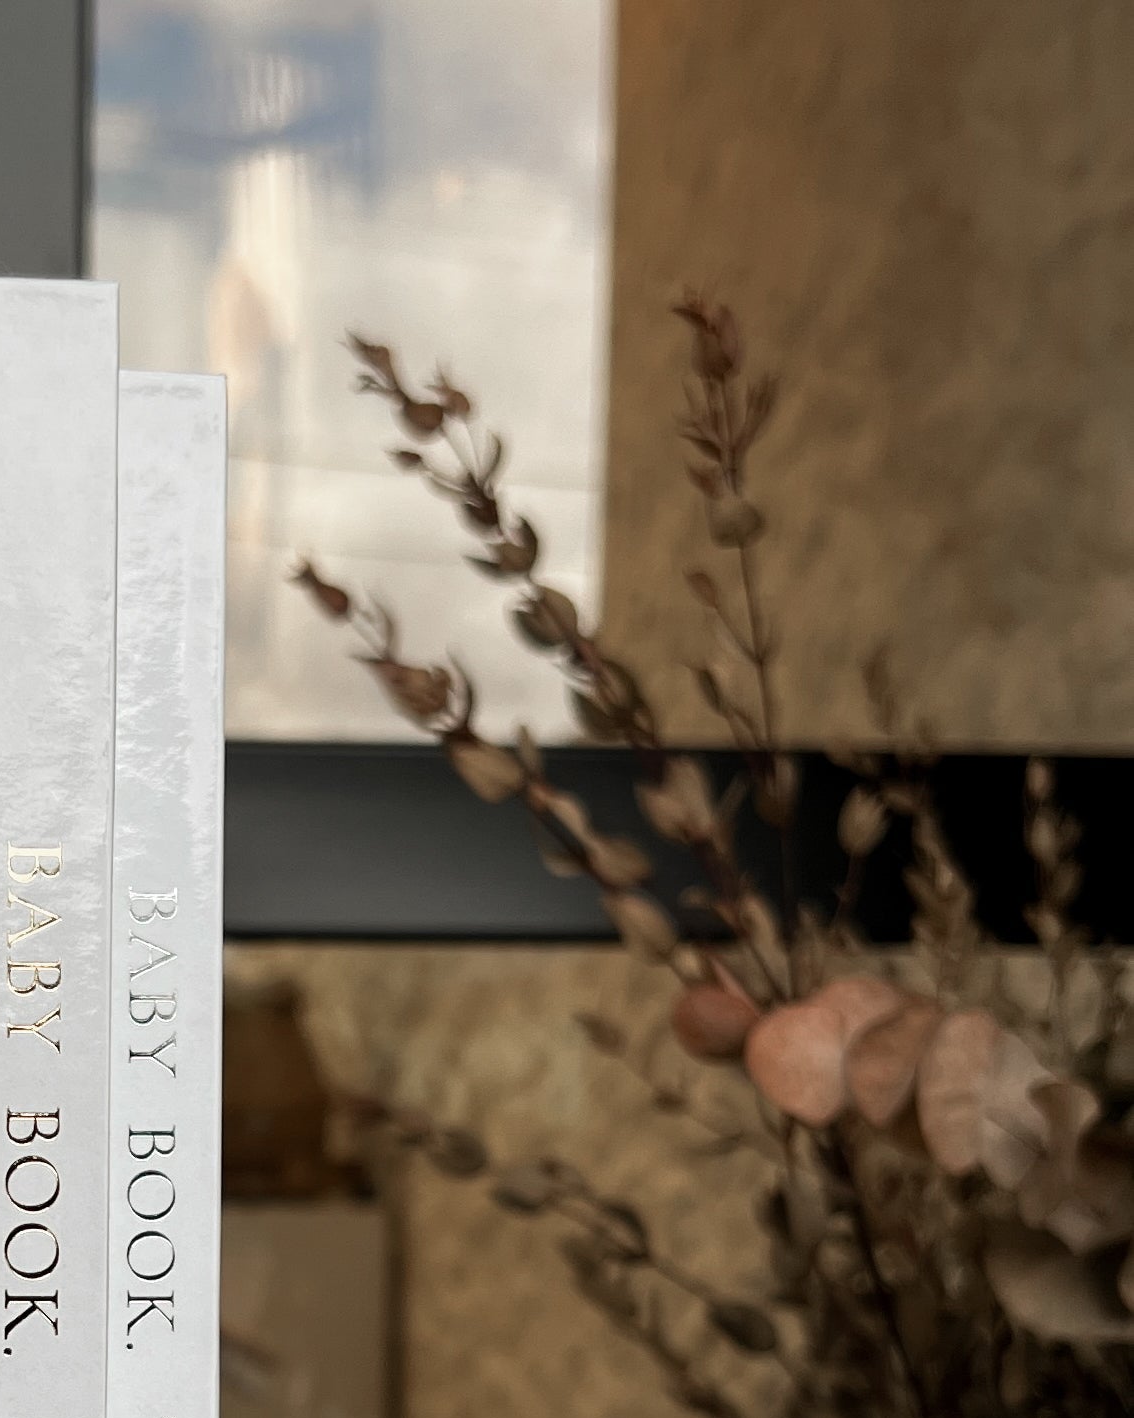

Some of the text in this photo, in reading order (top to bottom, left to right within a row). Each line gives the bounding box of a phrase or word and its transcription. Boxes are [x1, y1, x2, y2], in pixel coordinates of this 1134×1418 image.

[6, 840, 63, 1054] BABY
[127, 886, 178, 1079] BABY
[3, 1107, 61, 1356] BOOK.
[126, 1124, 176, 1351] BOOK.
